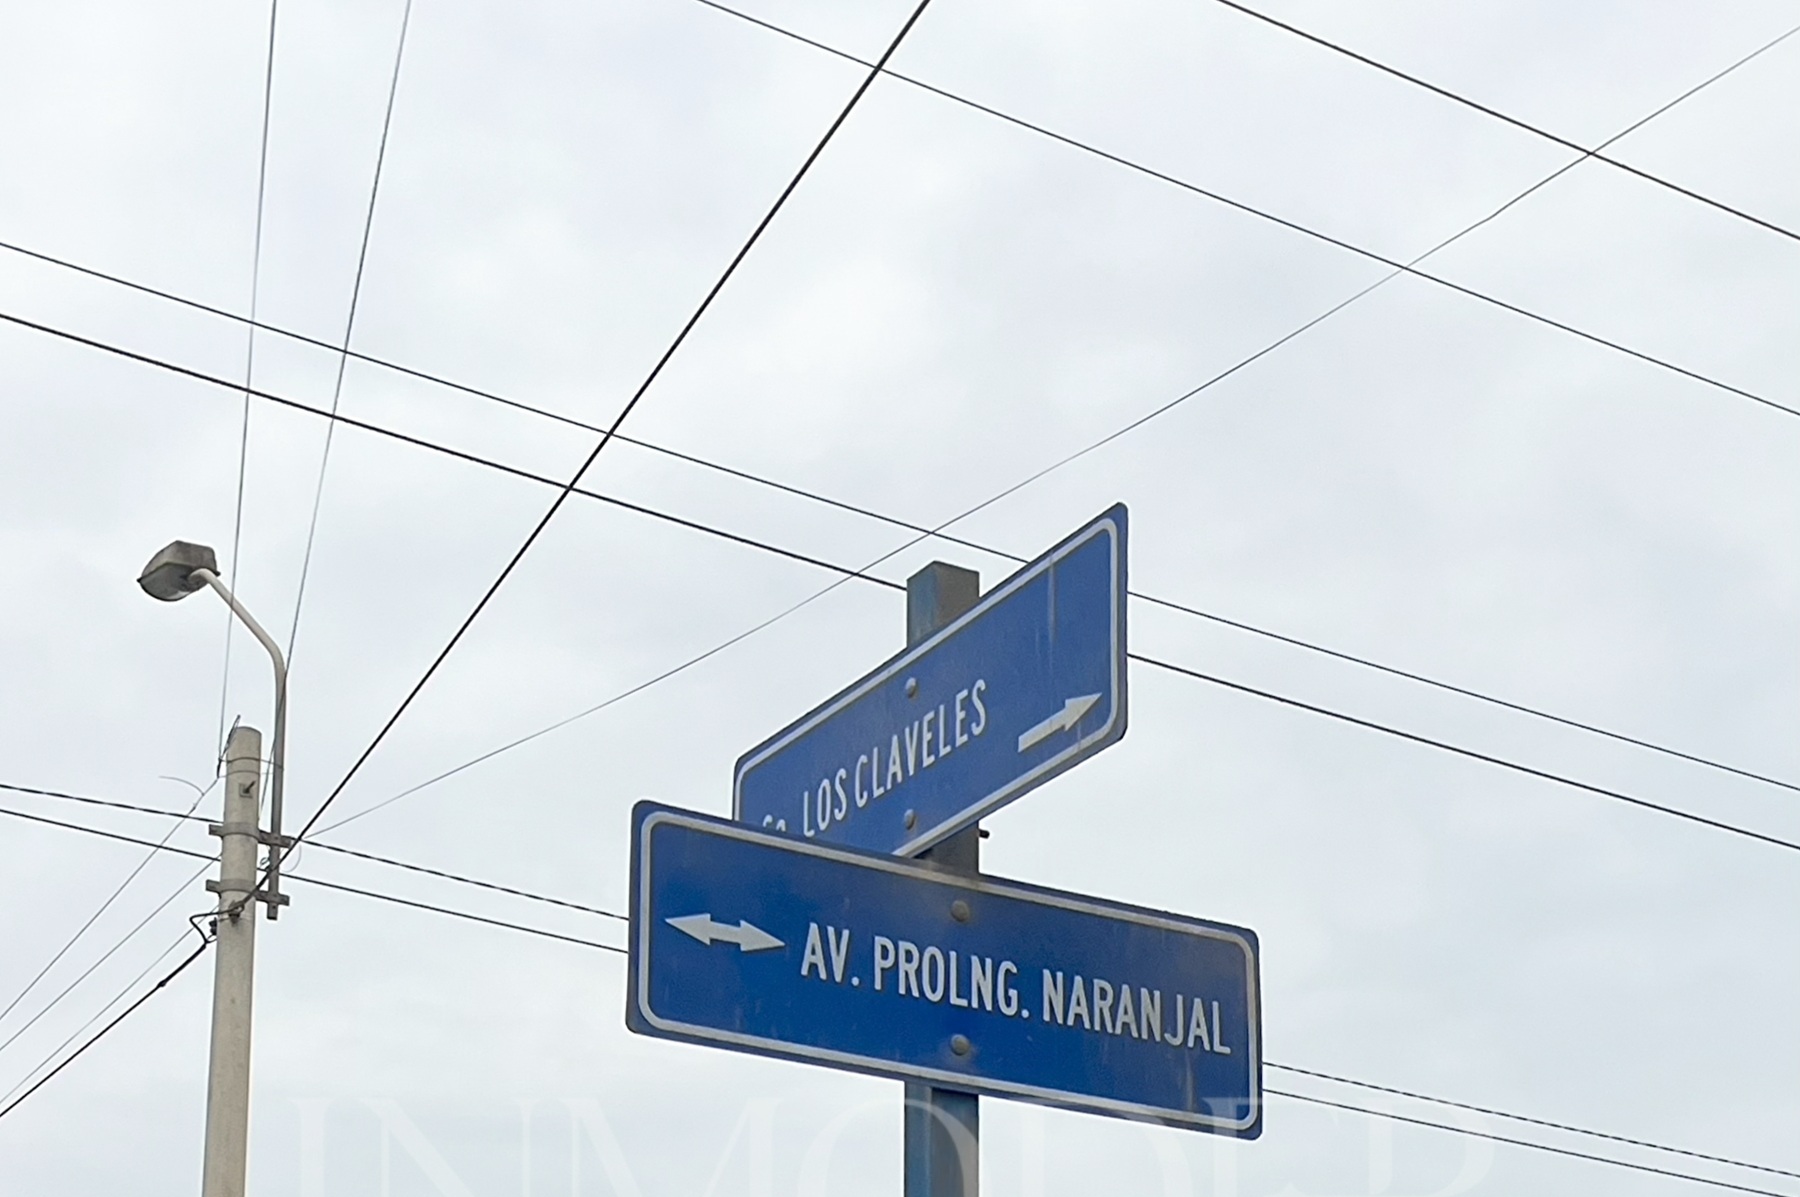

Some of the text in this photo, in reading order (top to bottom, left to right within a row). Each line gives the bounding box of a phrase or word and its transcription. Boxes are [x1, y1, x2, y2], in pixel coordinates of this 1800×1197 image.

[803, 679, 986, 837] LOS CLAVELES
[800, 922, 1232, 1055] AV. PROLNG. NARANJAL
